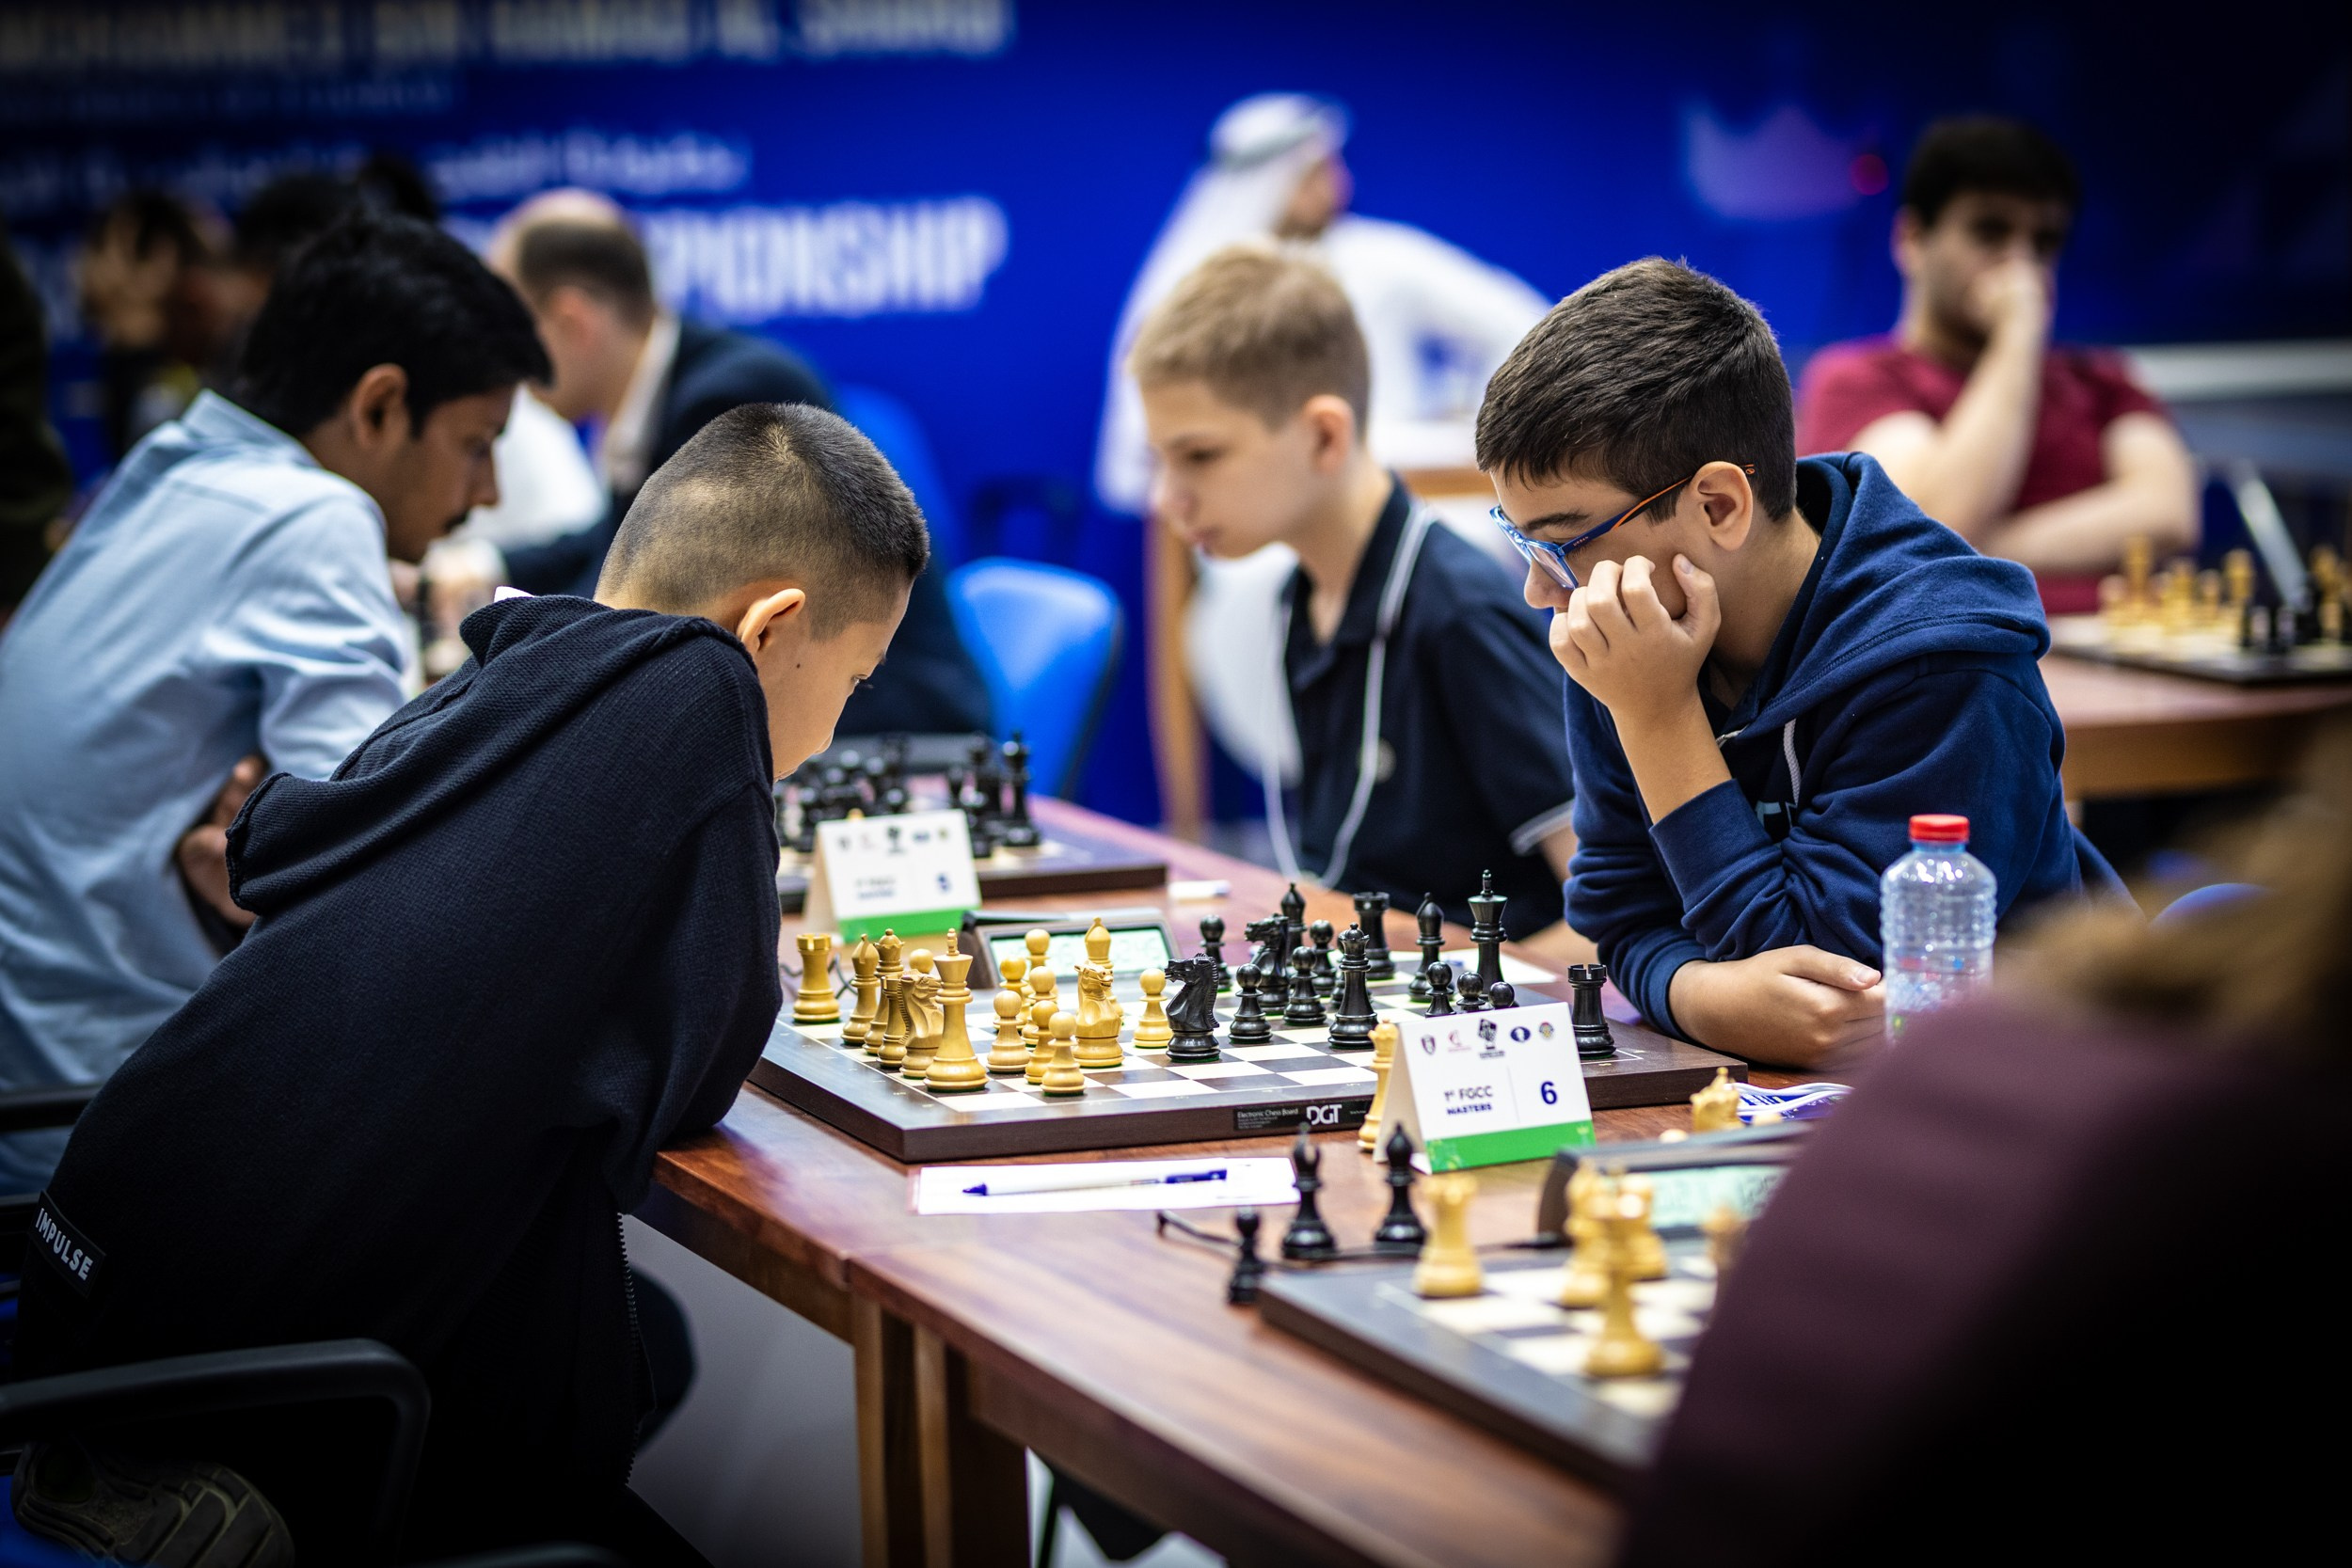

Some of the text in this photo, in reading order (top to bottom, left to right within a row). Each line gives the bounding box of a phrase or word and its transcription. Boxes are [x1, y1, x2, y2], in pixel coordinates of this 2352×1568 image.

[1459, 1085, 1493, 1100] FGCC
[1540, 1081, 1558, 1105] 6
[1281, 1108, 1298, 1117] Board
[1306, 1104, 1343, 1125] DGT
[1447, 1103, 1492, 1115] MASTERS
[35, 1207, 94, 1281] IMPULSE
